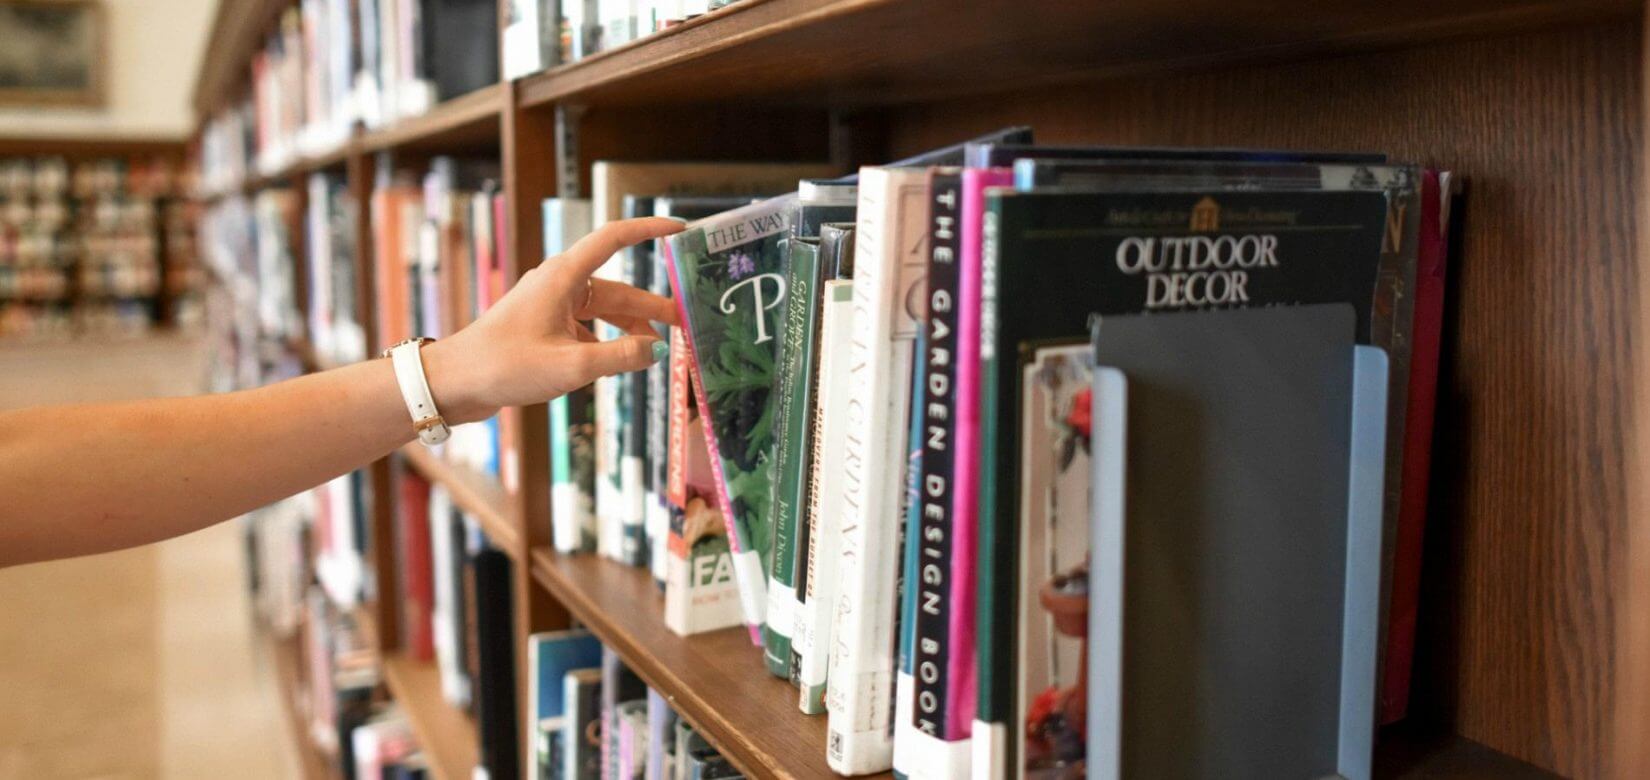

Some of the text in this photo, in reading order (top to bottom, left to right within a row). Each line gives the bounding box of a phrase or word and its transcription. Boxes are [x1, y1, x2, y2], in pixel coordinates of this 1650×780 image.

[707, 221, 747, 248] THE
[1115, 234, 1279, 275] OUTDOOR
[719, 272, 786, 345] P
[1145, 270, 1249, 308] DECOR
[794, 280, 807, 350] GARDEN
[671, 382, 686, 496] GARDENS
[814, 408, 824, 472] MAKEOVERS
[918, 189, 956, 737] THE GARDEN DESIGN BOOK
[778, 495, 790, 531] John
[811, 479, 820, 508] FROM
[810, 513, 818, 533] THE
[775, 532, 788, 578] Dixon
